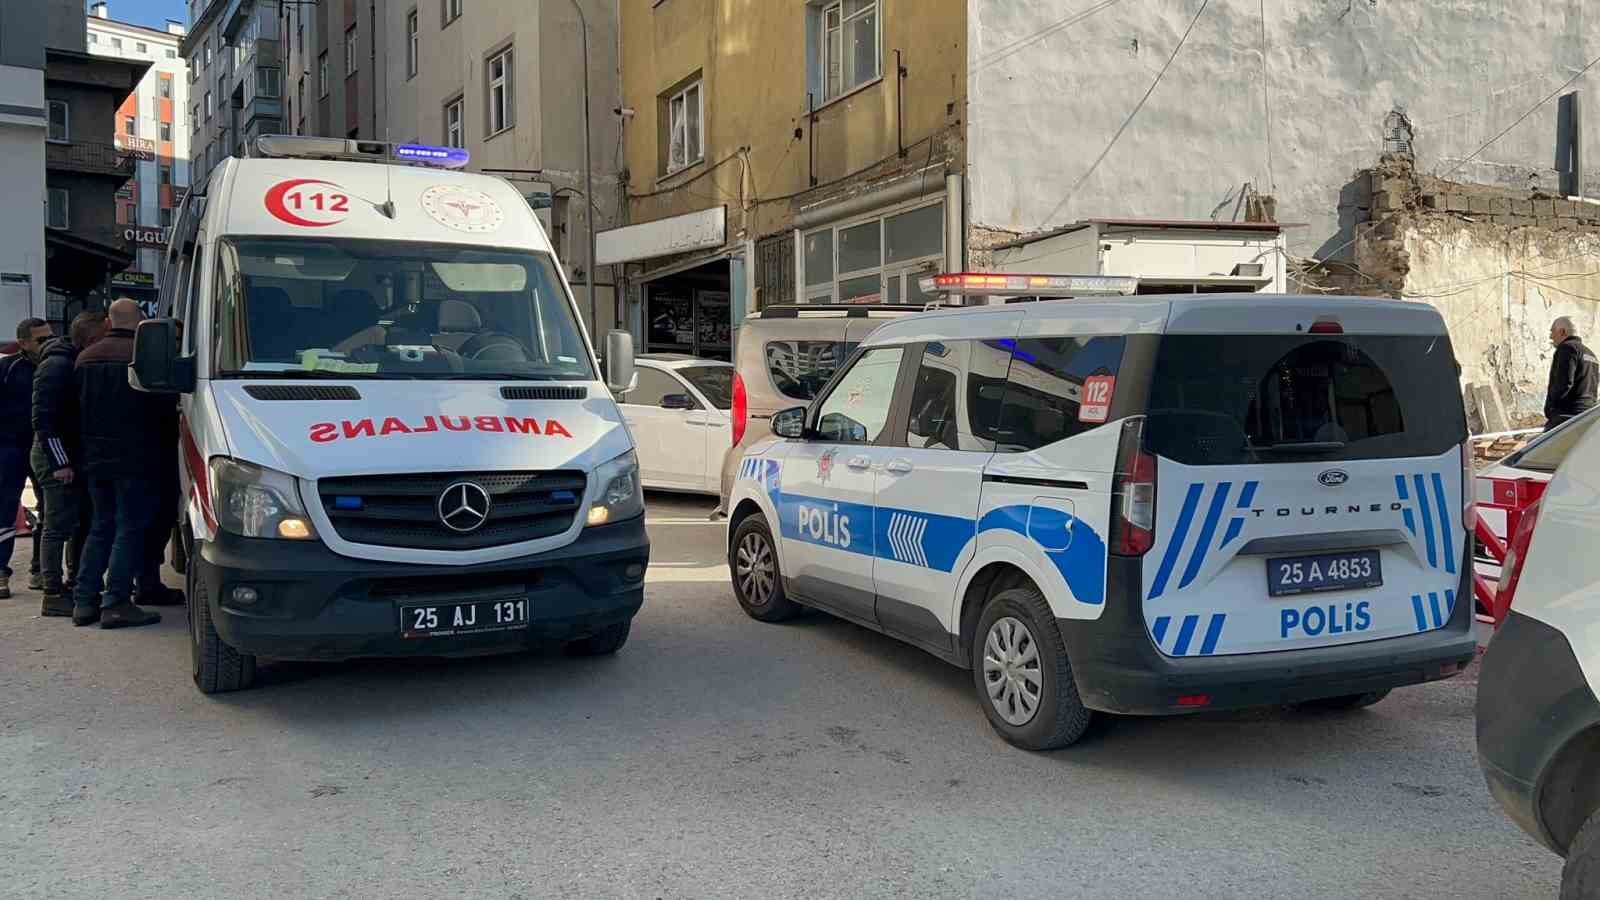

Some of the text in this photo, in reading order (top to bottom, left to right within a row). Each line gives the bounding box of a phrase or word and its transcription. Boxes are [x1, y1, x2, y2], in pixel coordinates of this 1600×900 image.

[287, 191, 350, 212] 112
[123, 228, 169, 244] OLGU
[1087, 381, 1109, 403] 112
[1251, 502, 1402, 518] TOURNEO
[1280, 557, 1372, 585] 25 A 4853
[414, 600, 525, 629] 25 AJ 131
